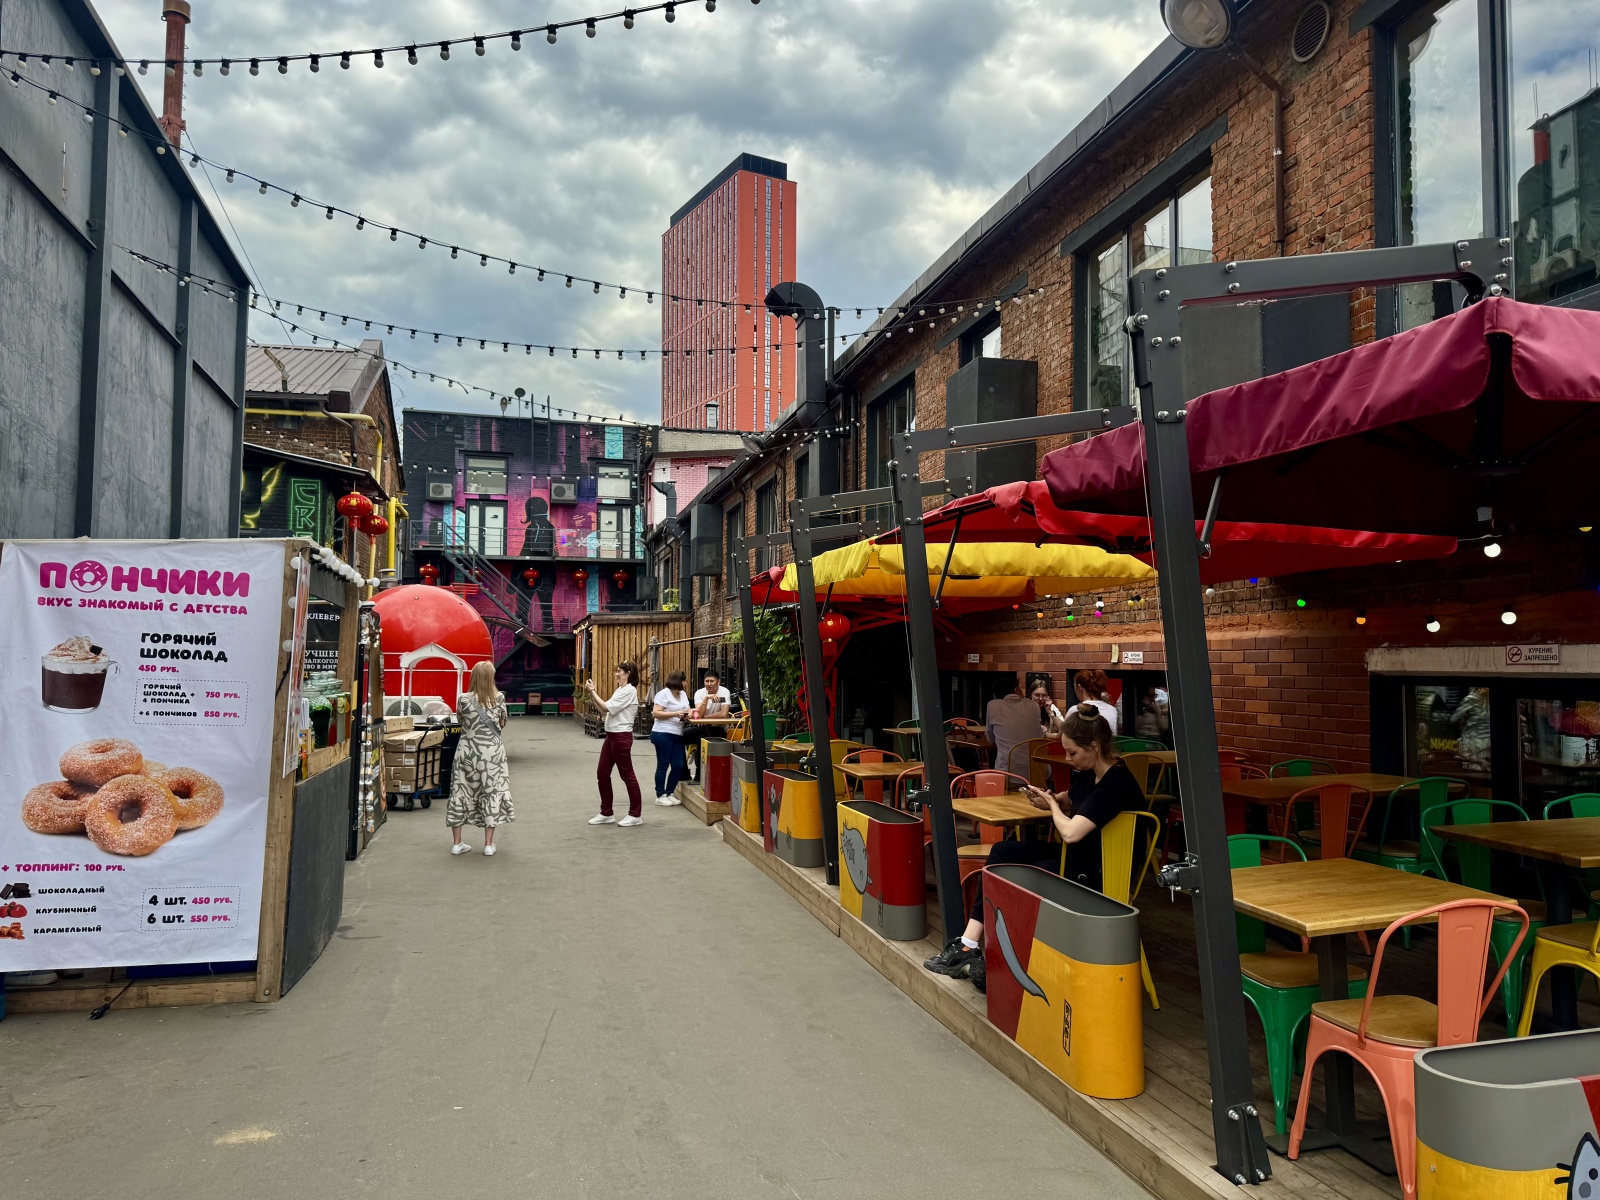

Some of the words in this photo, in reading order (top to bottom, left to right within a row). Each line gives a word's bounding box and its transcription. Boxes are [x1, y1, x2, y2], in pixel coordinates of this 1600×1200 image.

[295, 484, 317, 537] CR
[39, 559, 250, 598] ПОНЧИКИ
[37, 597, 73, 608] ВКУС
[78, 598, 164, 611] ЗНАКОМЫЙ
[169, 602, 179, 612] С
[183, 603, 248, 615] ДЕТСТВА
[141, 631, 217, 646] ГОРЯЧИЙ
[139, 647, 229, 663] ШОКОЛАД
[138, 664, 157, 673] 450
[160, 666, 180, 674] РУБ.
[143, 683, 182, 691] ГОРЯЧИЙ
[143, 690, 187, 698] ШОКОЛАД
[205, 691, 221, 699] 750
[150, 697, 191, 705] ПОНЧИКА
[203, 710, 221, 718] 850
[15, 863, 80, 872] ТОППИНГ:
[84, 863, 102, 872] 100
[105, 864, 126, 872] РУБ.
[37, 885, 105, 895] ШОКОЛАДНЫЙ
[148, 894, 159, 906] 4
[164, 896, 188, 906] ШТ.
[191, 896, 211, 905] 450
[35, 905, 97, 915] КЛУБНИЧНЫЙ
[147, 913, 157, 924] 6
[162, 914, 185, 924] ШТ.
[190, 914, 209, 923] 550
[33, 925, 102, 935] КАРАМЕЛЬНЫЙ
